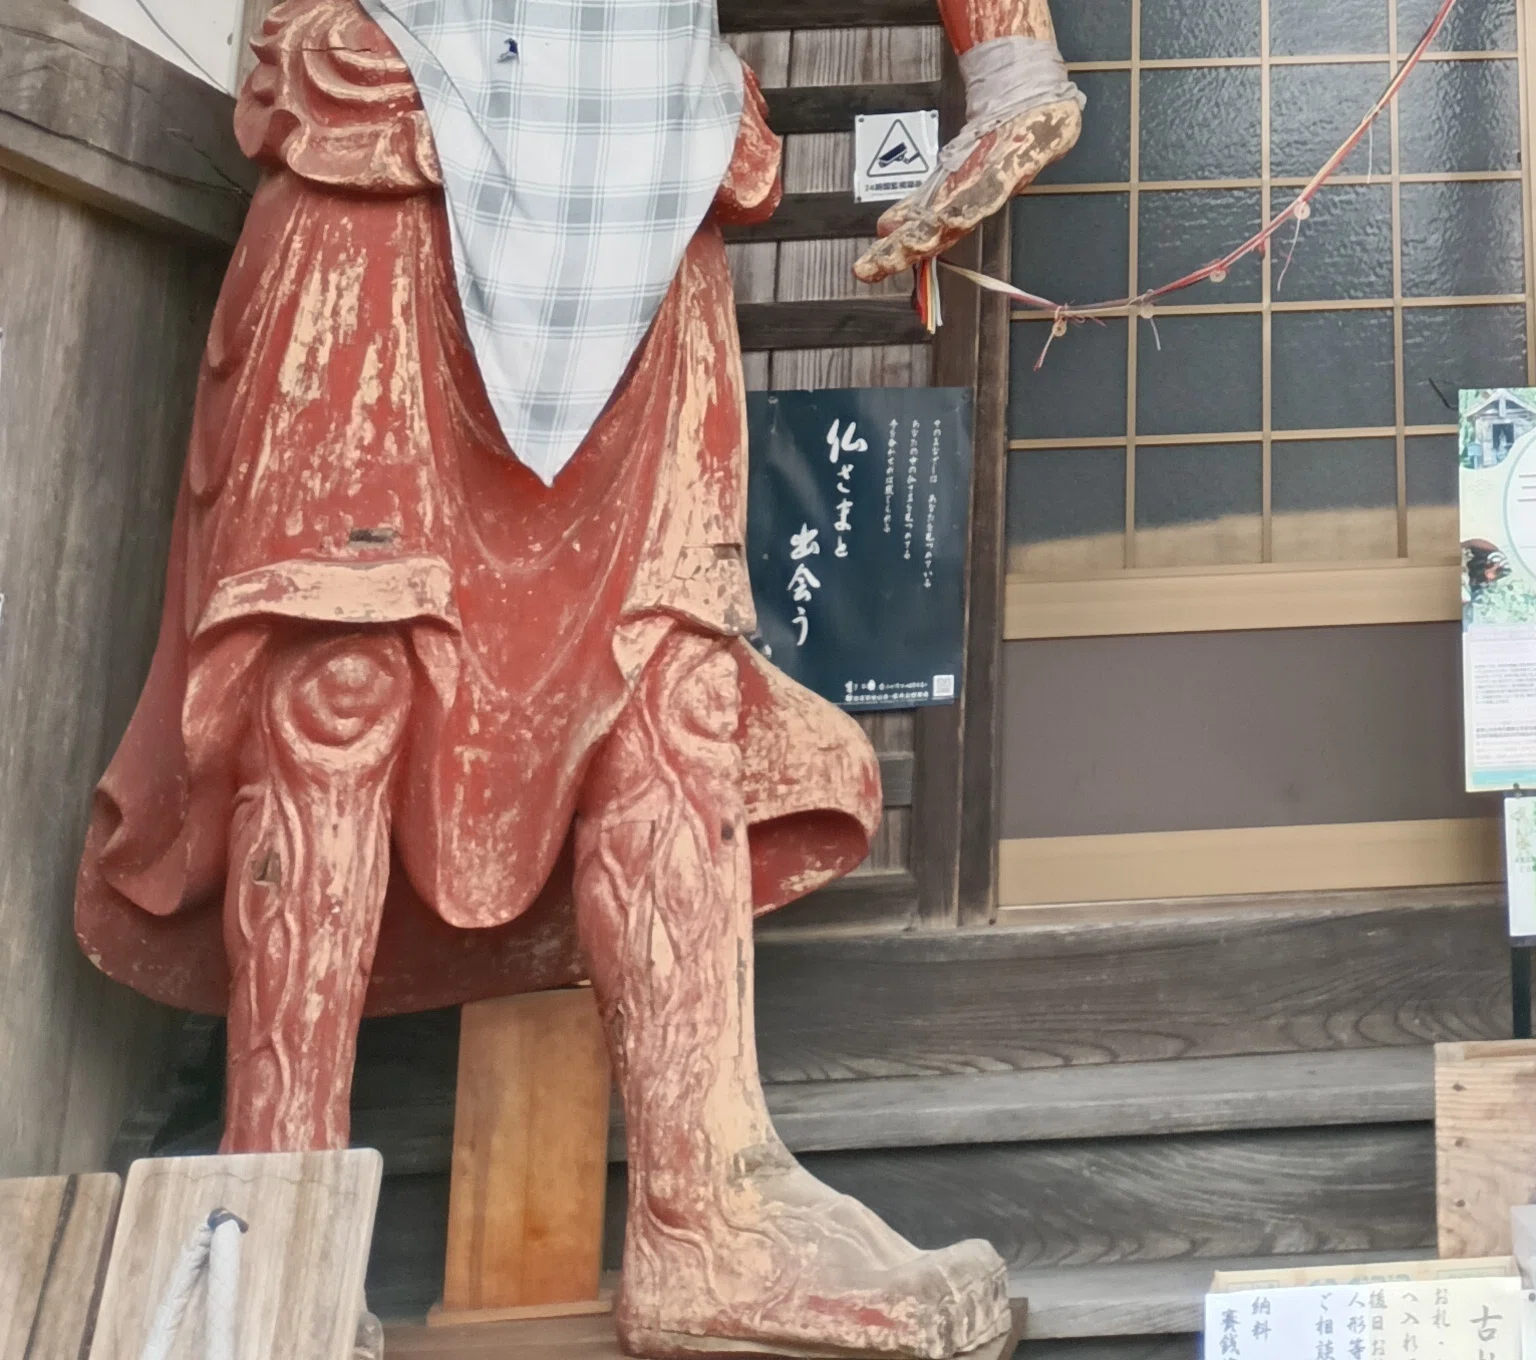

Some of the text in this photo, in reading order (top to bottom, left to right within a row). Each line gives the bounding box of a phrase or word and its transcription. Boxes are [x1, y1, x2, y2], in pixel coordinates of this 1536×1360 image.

[826, 418, 868, 558] 仏さまと
[787, 523, 821, 647] 出会う
[1400, 1292, 1420, 1360] へ入れ
